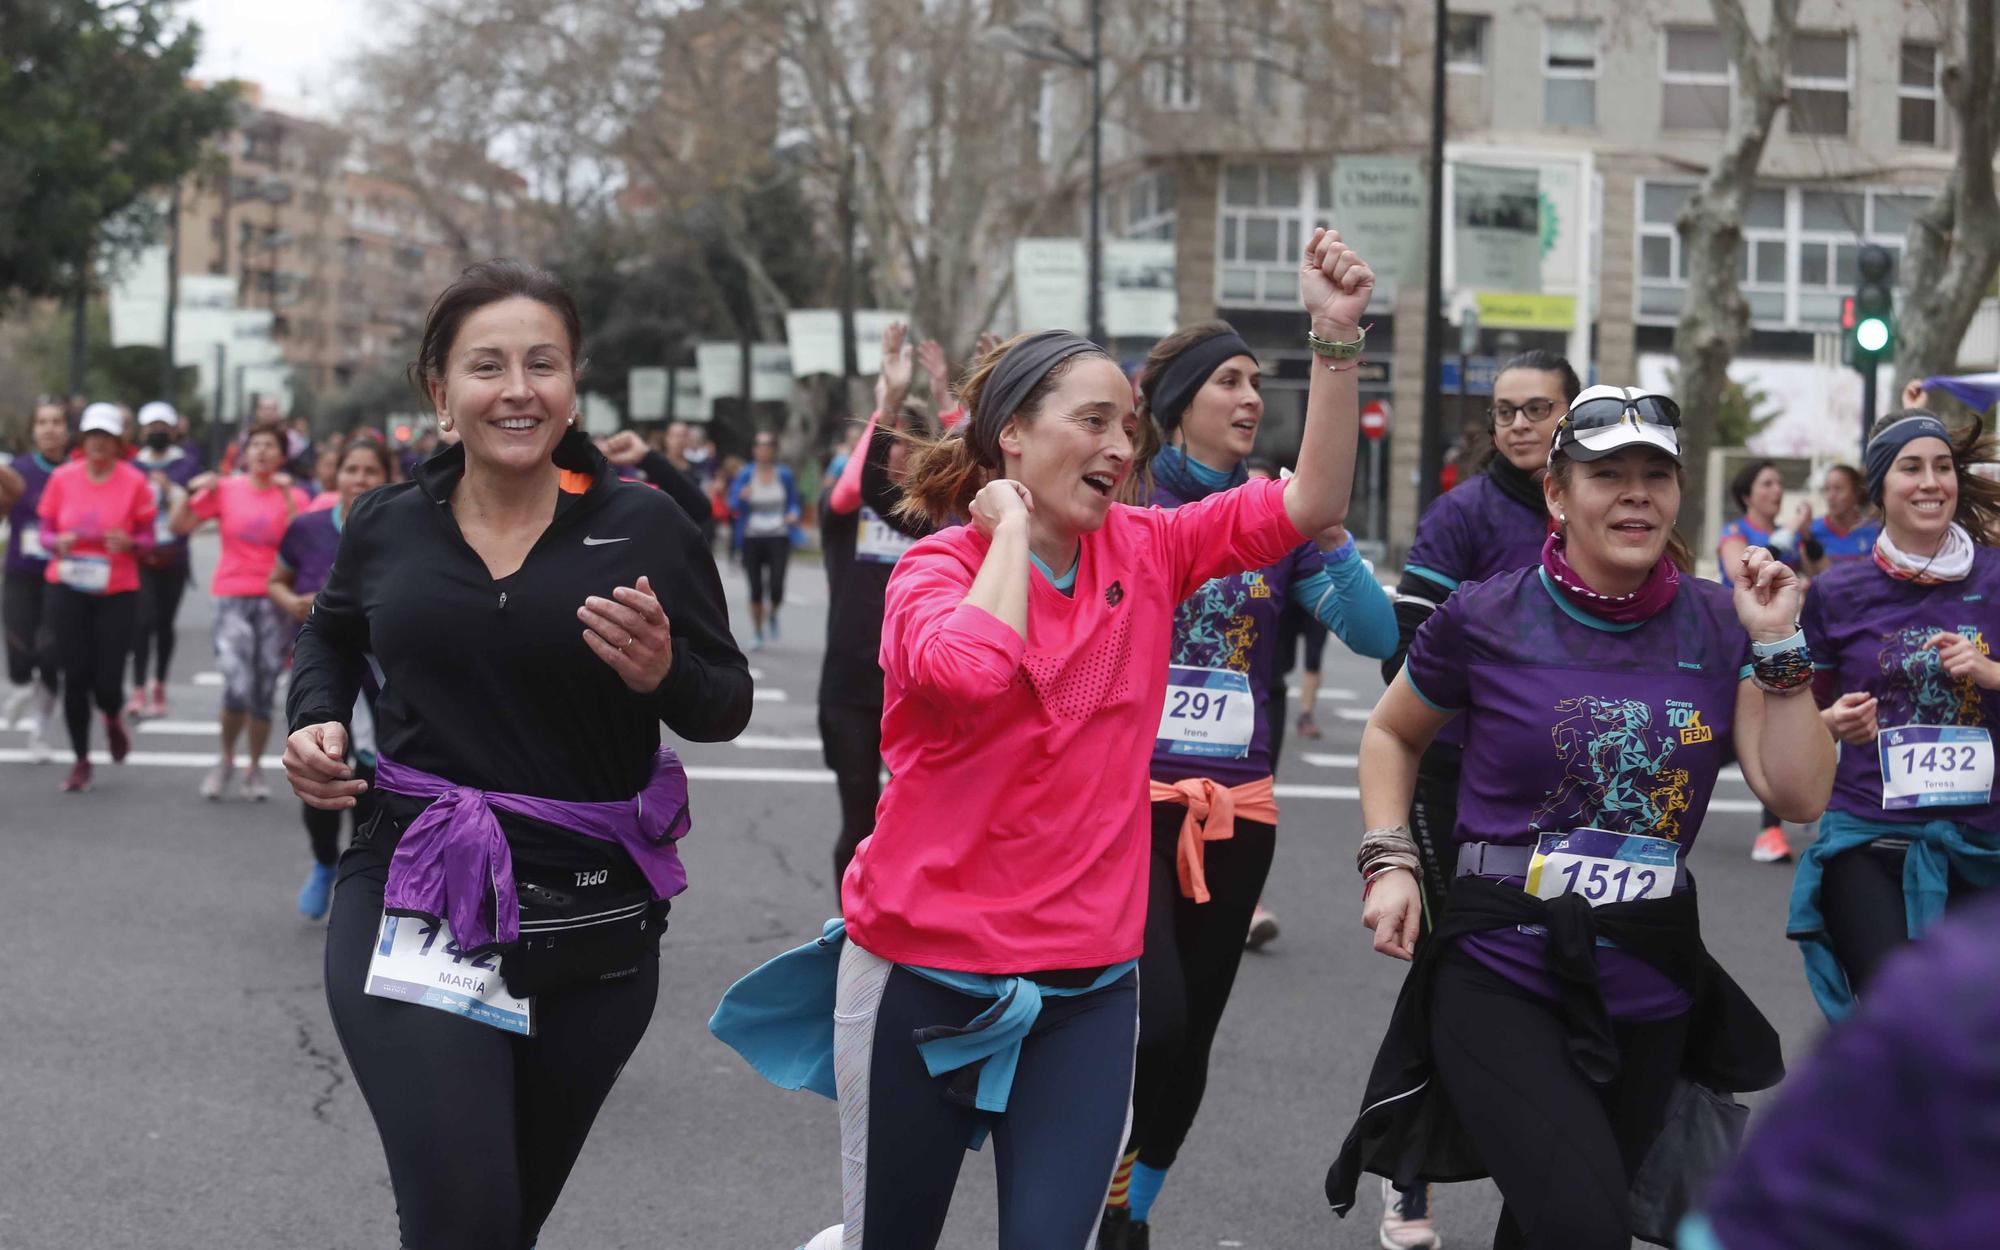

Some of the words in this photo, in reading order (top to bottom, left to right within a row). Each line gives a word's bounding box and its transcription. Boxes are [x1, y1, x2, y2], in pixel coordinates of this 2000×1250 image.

[1169, 690, 1228, 722] 291
[1665, 699, 1693, 708] Carrera
[1666, 708, 1701, 729] 10K
[1184, 728, 1208, 737] Irene
[1682, 728, 1710, 743] FEM
[1903, 746, 1976, 774] 1432
[1925, 780, 1954, 789] Teresa
[574, 869, 608, 887] OPEL
[1562, 860, 1656, 902] 1512
[439, 972, 486, 995] MARÍA
